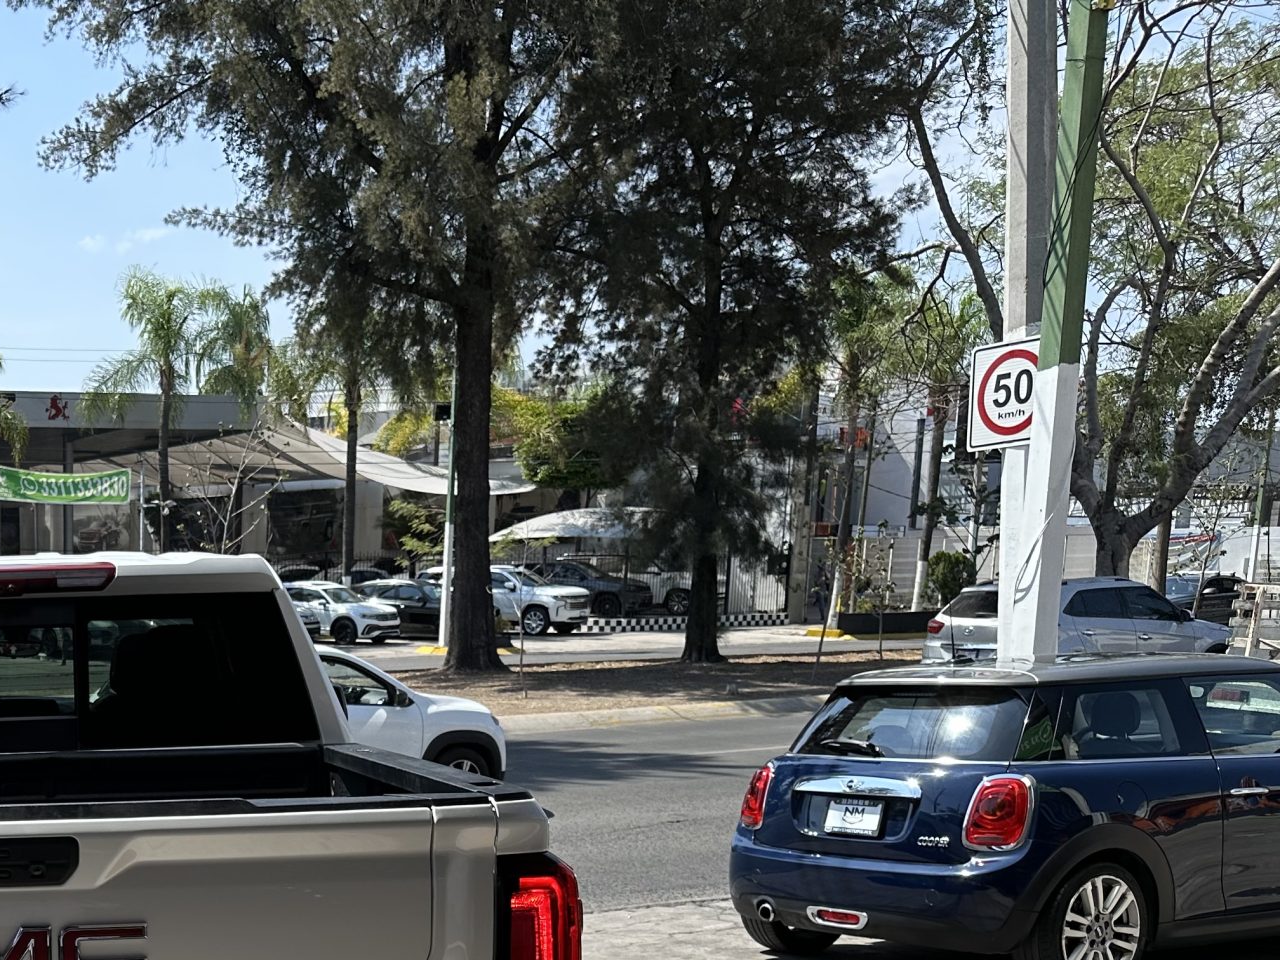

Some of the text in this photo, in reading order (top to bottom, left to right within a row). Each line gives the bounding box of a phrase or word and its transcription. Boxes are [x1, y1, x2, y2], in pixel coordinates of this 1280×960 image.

[992, 369, 1034, 408] 50
[997, 409, 1026, 420] km/h
[38, 474, 128, 498] 3311333830
[843, 806, 866, 818] NM
[916, 836, 951, 848] COOPER
